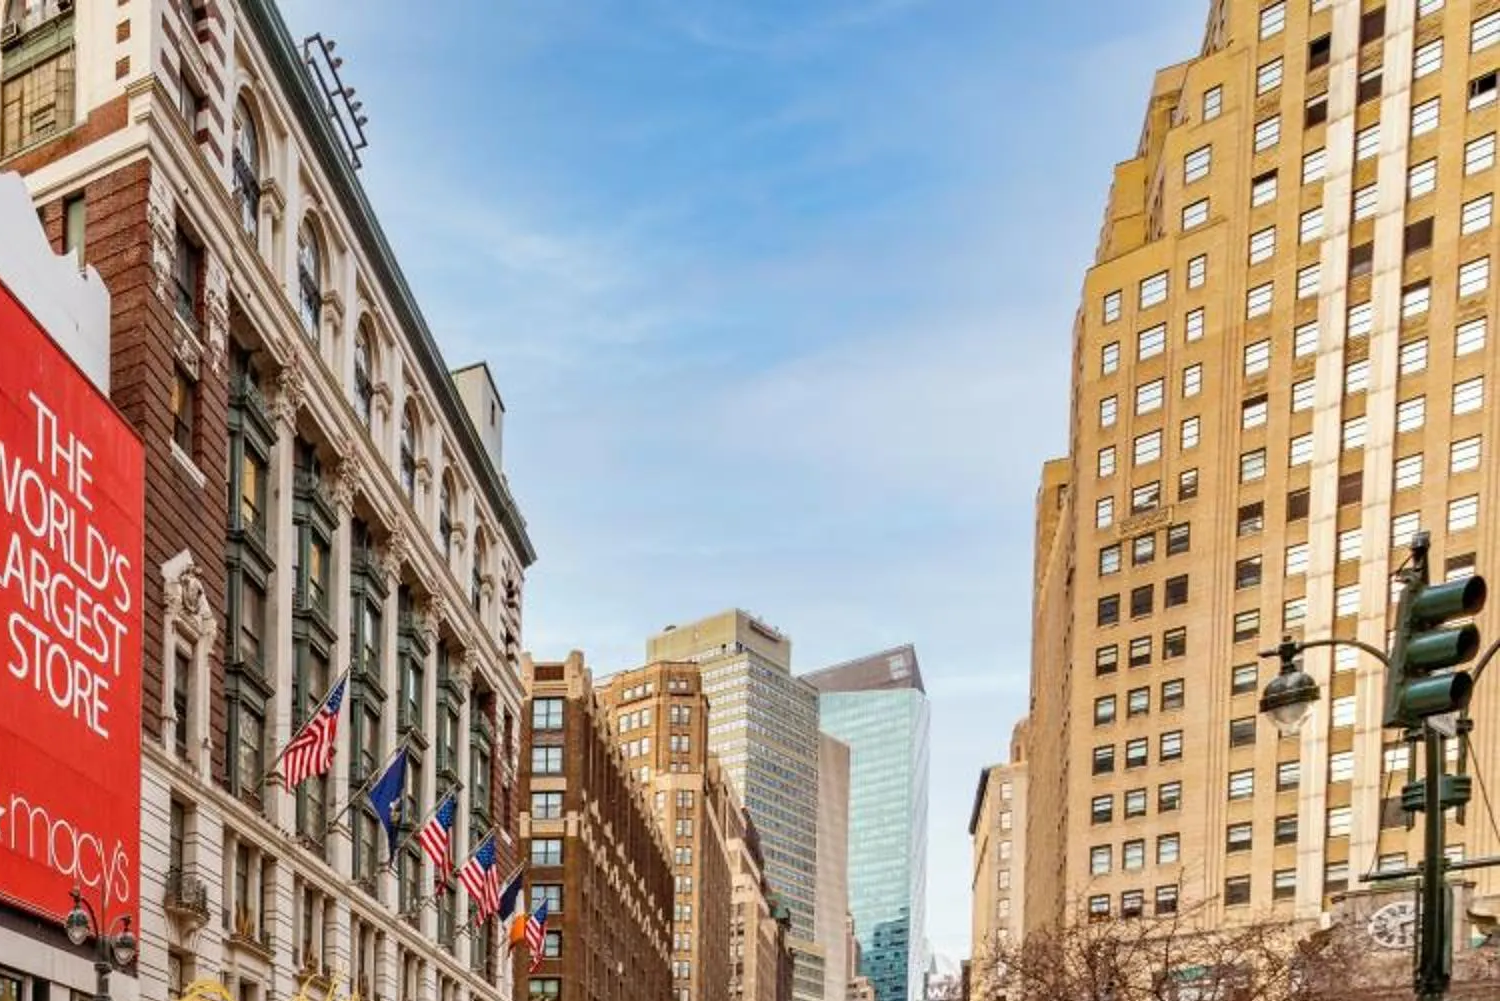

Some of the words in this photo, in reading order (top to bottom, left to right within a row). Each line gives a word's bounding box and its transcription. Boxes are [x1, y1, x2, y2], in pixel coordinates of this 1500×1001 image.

[28, 391, 94, 511] THE
[8, 618, 110, 740] STORE
[10, 794, 131, 909] macy's
